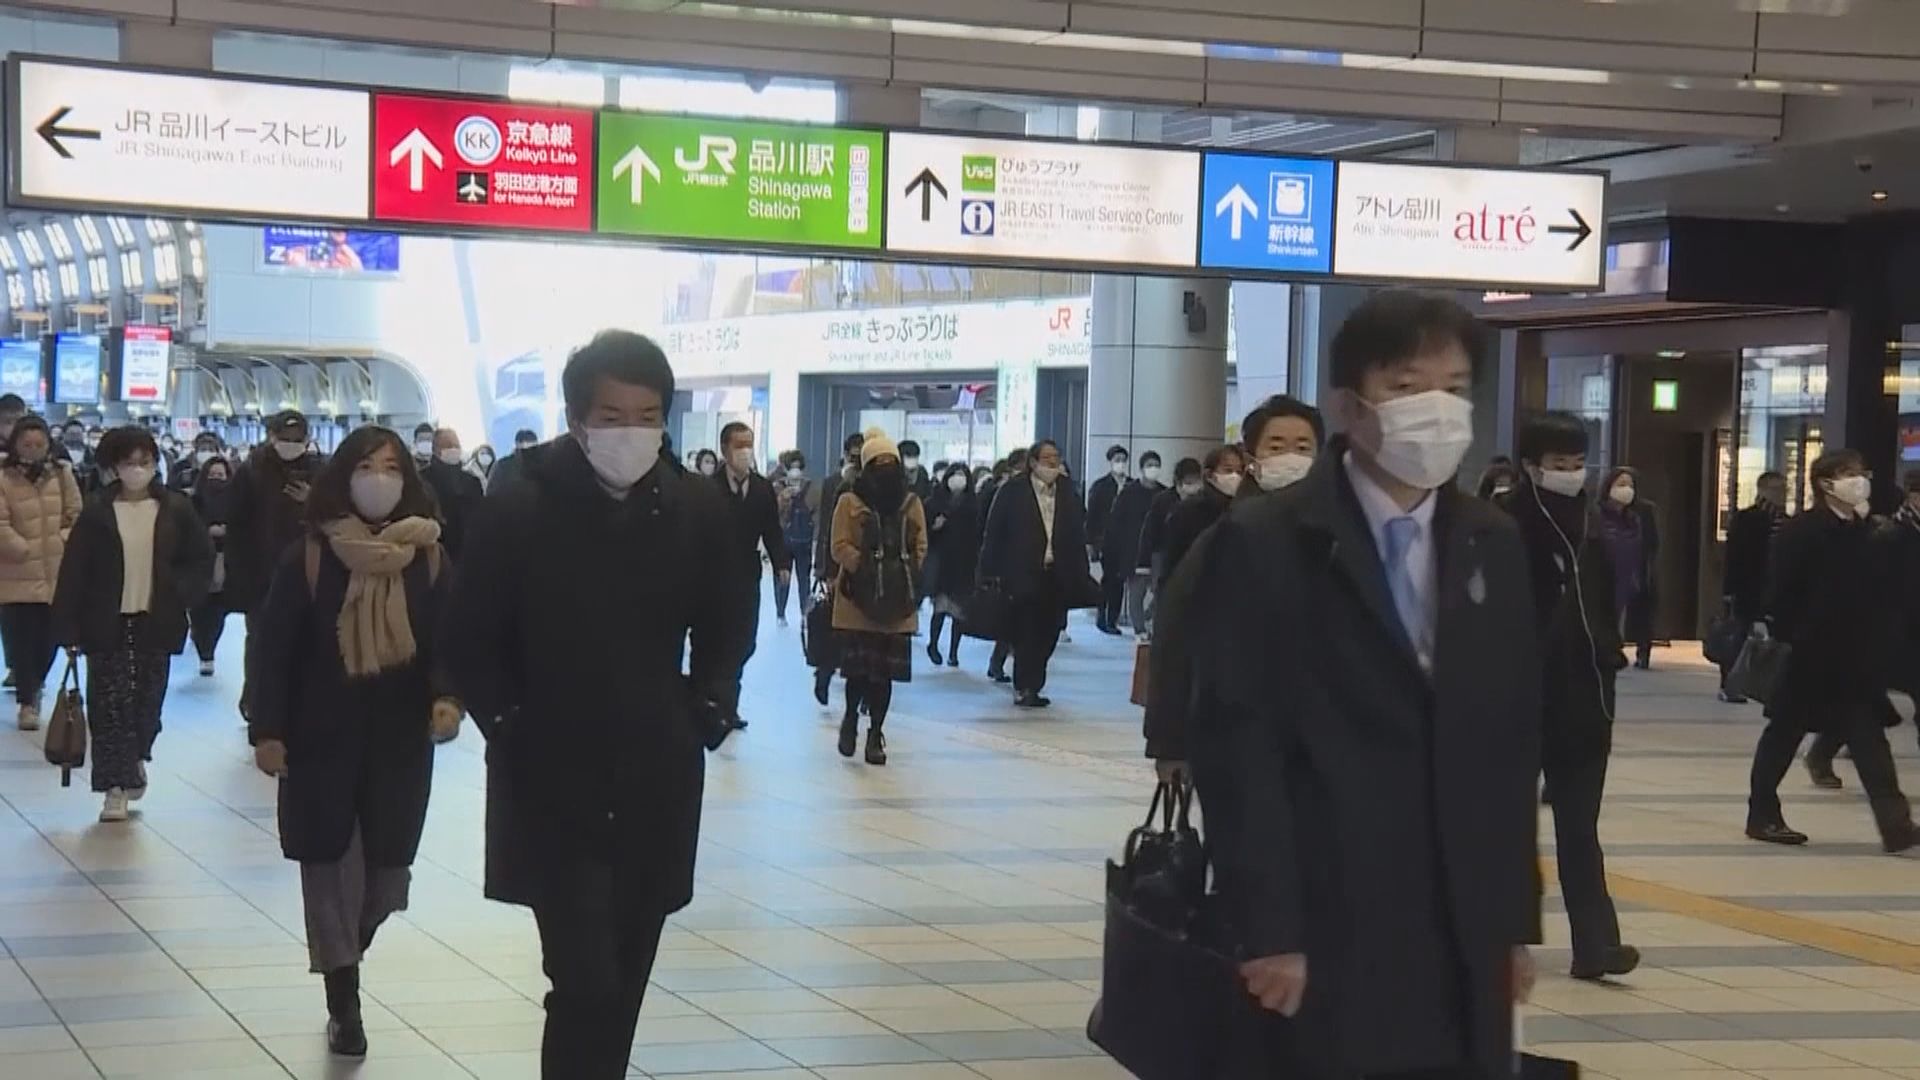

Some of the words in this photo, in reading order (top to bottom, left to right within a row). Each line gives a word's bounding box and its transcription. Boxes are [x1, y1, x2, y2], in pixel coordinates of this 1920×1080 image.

[115, 108, 151, 133] JR
[159, 112, 347, 149] 品川イーストビル
[464, 131, 491, 149] KK
[506, 120, 572, 147] 京急線
[115, 140, 137, 156] JR
[144, 142, 234, 164] Shinagawa
[240, 150, 276, 166] East
[281, 152, 343, 173] Building
[550, 149, 577, 164] Line
[674, 134, 738, 175] JR
[748, 139, 835, 177] 品川駅
[1000, 157, 1082, 176] びゅうプラザ
[494, 171, 578, 195] 羽田空港方面
[748, 176, 832, 201] Shinagawa
[508, 192, 543, 205] Haneda
[544, 193, 574, 209] Airport
[748, 198, 801, 220] Station
[1356, 195, 1441, 222] アトレ品川
[1000, 200, 1017, 217] JR
[1021, 201, 1054, 220] EAST
[1058, 203, 1095, 221] Travel
[1098, 206, 1143, 224] Service
[1145, 208, 1185, 226] Center
[1453, 202, 1537, 245] atré
[1268, 223, 1315, 244] 新幹線
[1380, 224, 1440, 240] Shinagawa
[1267, 243, 1319, 257] Shinkansen
[1049, 307, 1072, 331] JR
